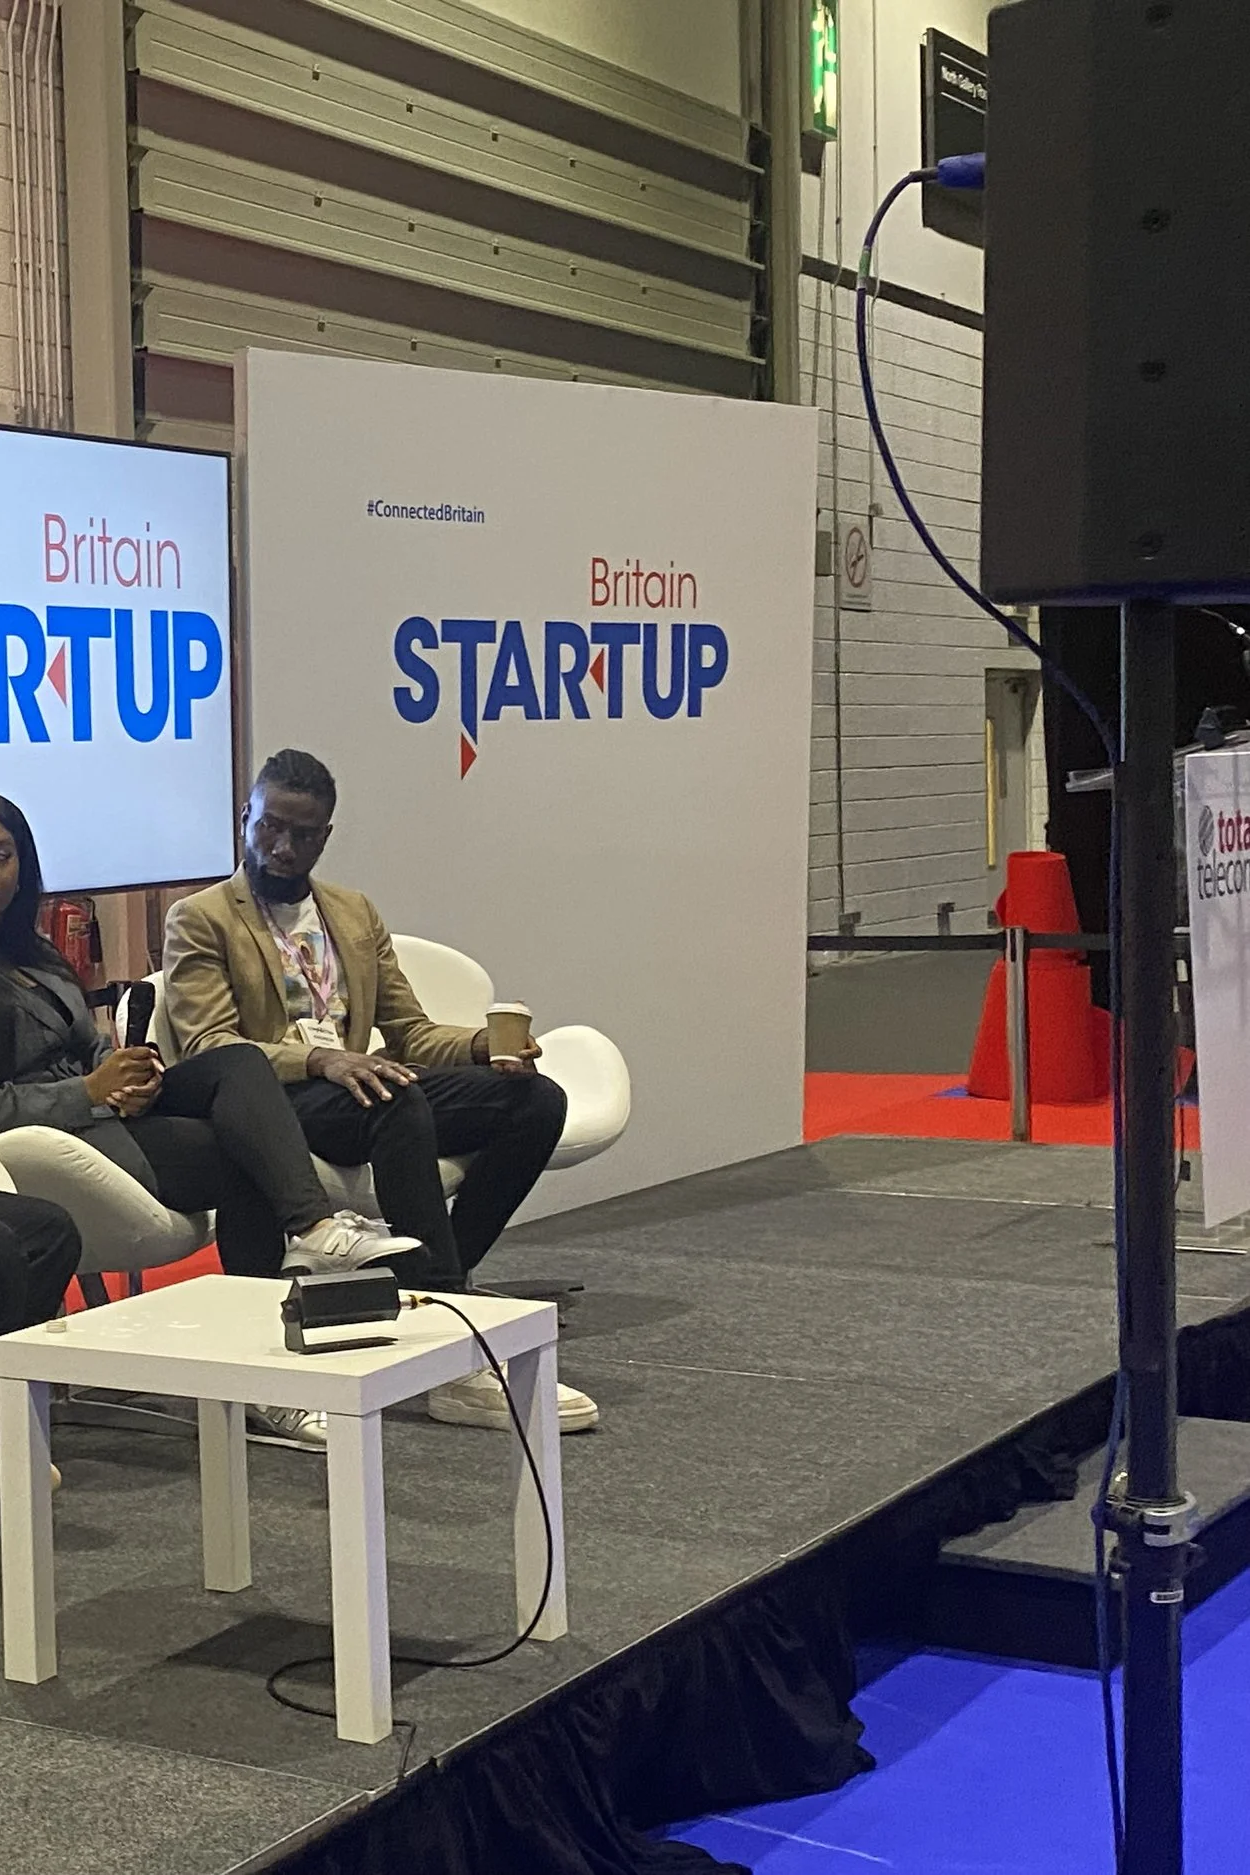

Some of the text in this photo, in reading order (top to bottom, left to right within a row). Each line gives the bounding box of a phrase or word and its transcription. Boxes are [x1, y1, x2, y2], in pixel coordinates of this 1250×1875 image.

[367, 500, 486, 525] #ConnectedBritain
[43, 513, 182, 590] Britain
[591, 557, 698, 609] Britain
[393, 616, 729, 745] STARTUP
